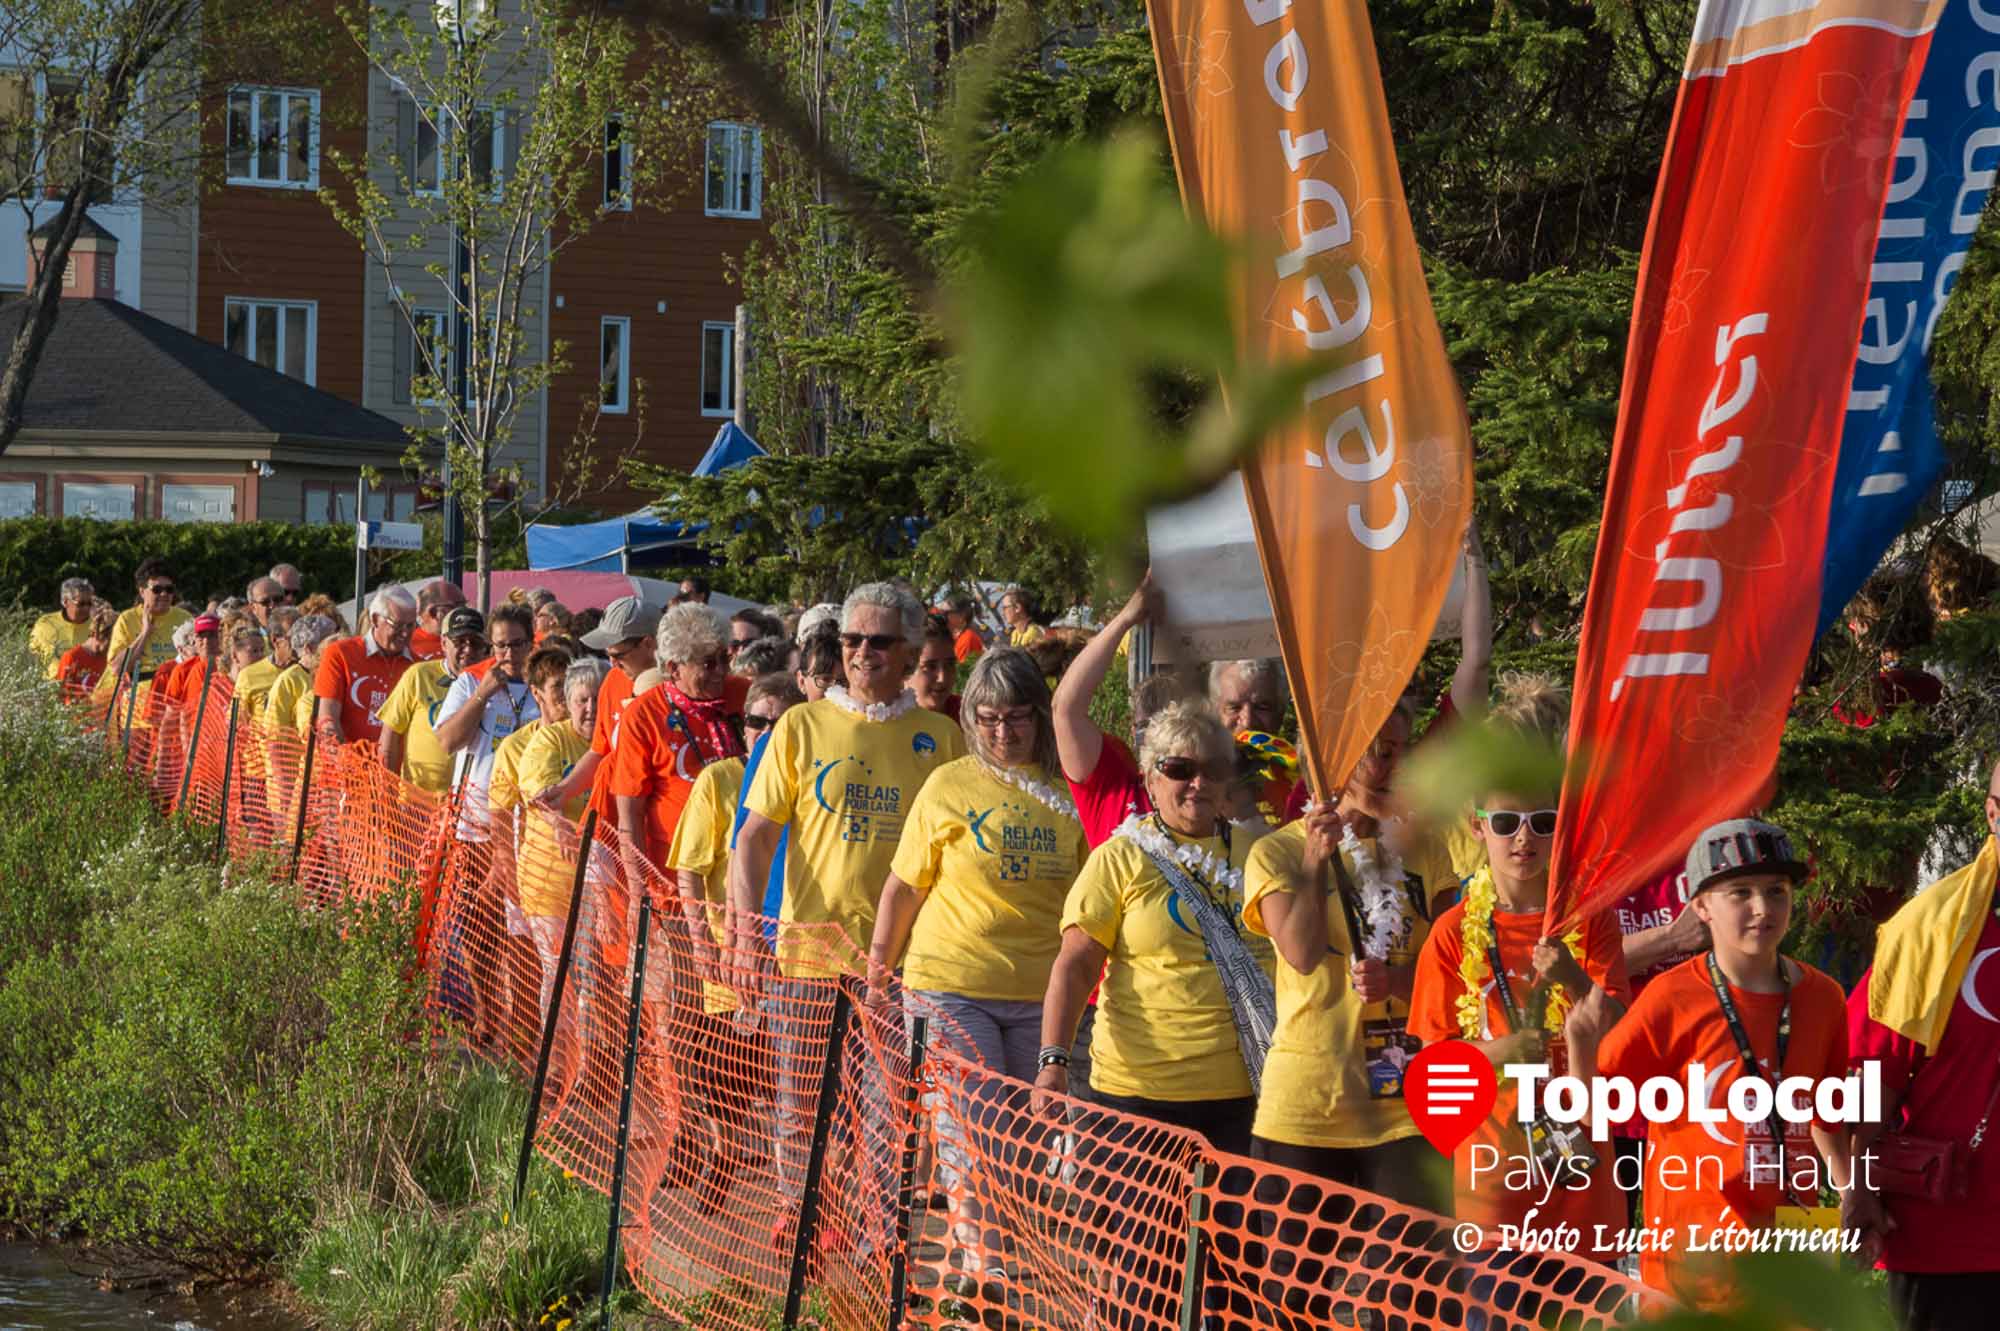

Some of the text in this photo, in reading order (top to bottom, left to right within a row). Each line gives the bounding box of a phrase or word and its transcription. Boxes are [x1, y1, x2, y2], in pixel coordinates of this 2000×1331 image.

[1609, 312, 1769, 702] lutter
[845, 783, 900, 801] RELAIS
[844, 798, 899, 814] POUR LA VIE
[1003, 825, 1057, 843] RELAIS
[1003, 839, 1057, 853] POUR LA VIE
[1616, 906, 1674, 930] ELAIS
